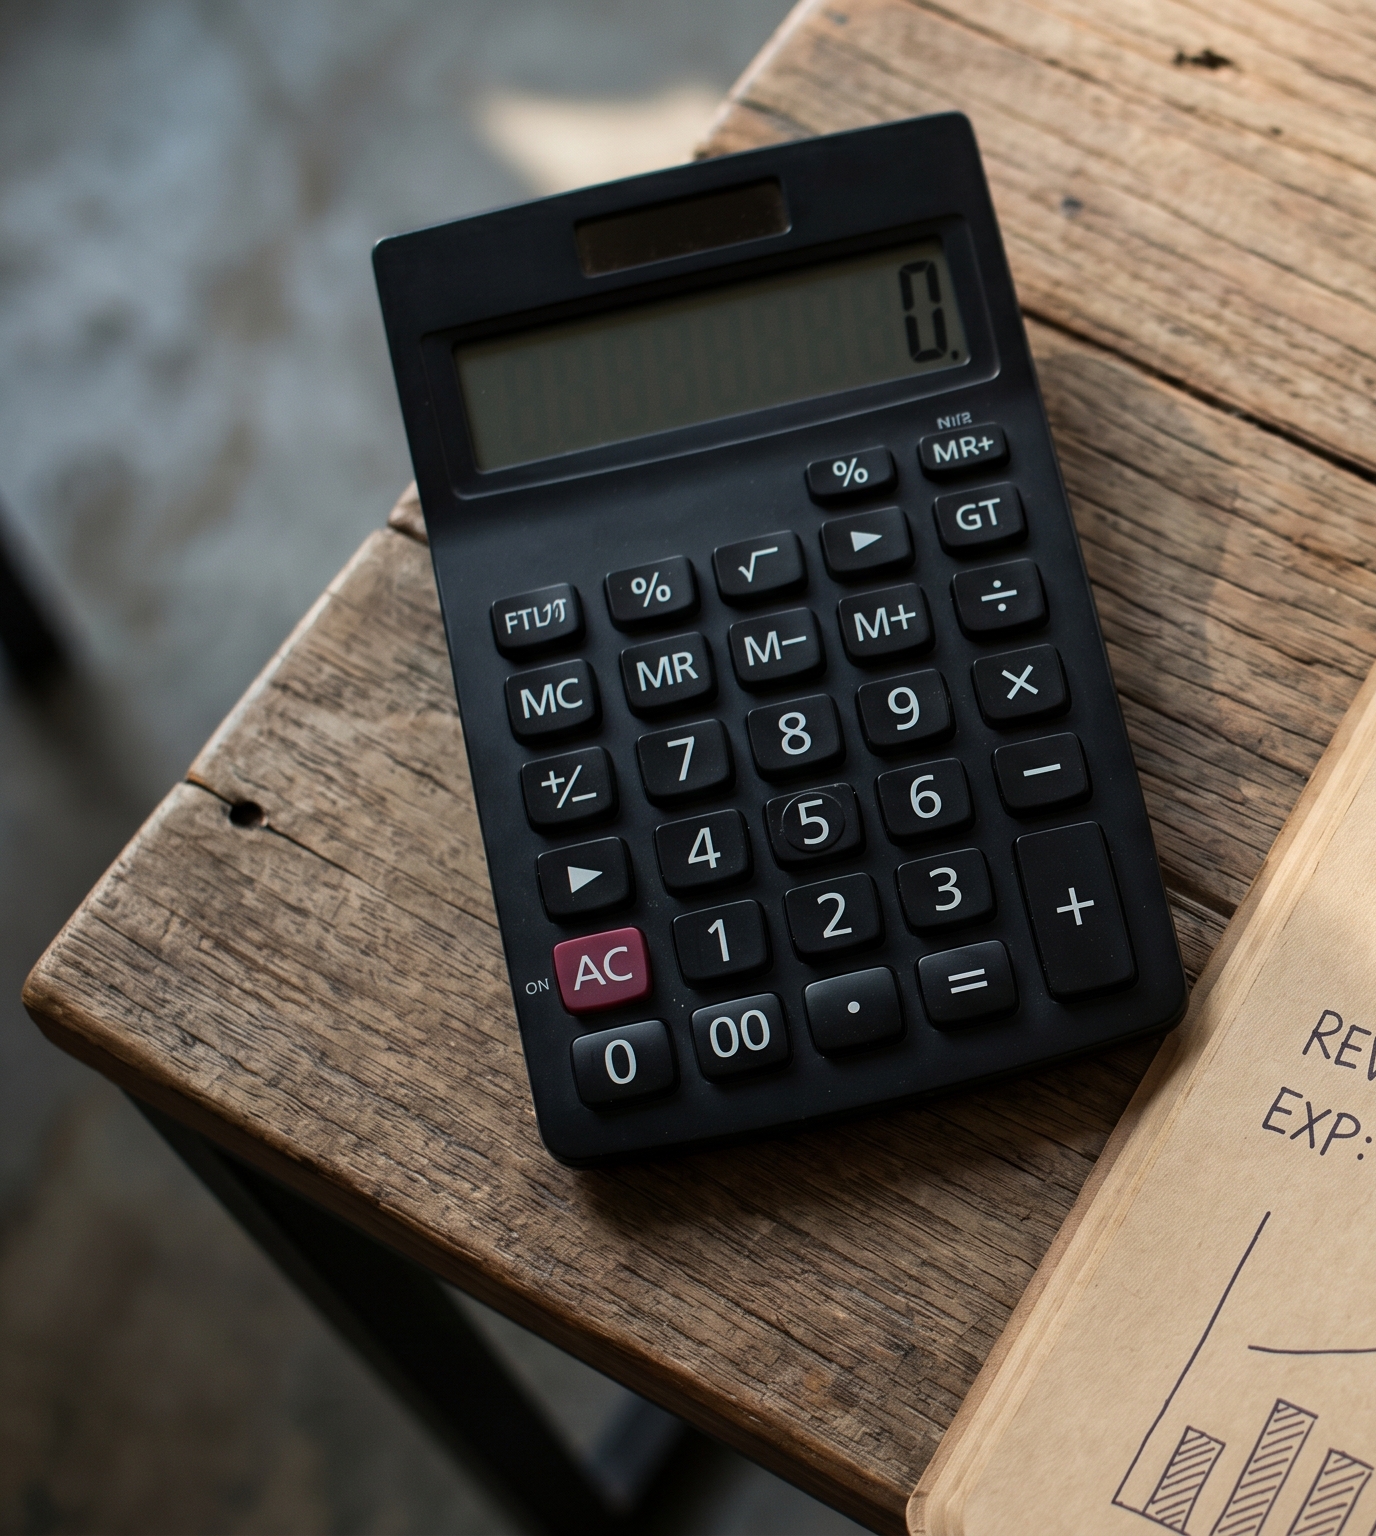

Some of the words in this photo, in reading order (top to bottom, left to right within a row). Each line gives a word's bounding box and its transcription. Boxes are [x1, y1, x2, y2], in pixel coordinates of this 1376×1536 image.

[933, 436, 994, 463] MR+
[955, 497, 1001, 531] GT
[853, 604, 916, 642] M+
[636, 651, 699, 692] MR
[520, 677, 583, 719] MC
[887, 687, 920, 731] 9
[778, 711, 812, 755] 8
[666, 735, 698, 782] 7
[910, 774, 942, 819] 6
[801, 798, 831, 846] 5
[687, 827, 721, 869] 4
[929, 867, 962, 911] 3
[816, 892, 853, 938] 2
[707, 918, 730, 962] 1
[525, 978, 550, 995] ON
[573, 945, 633, 991] AC
[709, 1008, 770, 1058] 00
[604, 1039, 637, 1085] 0
[1261, 1086, 1373, 1161] EXP:
